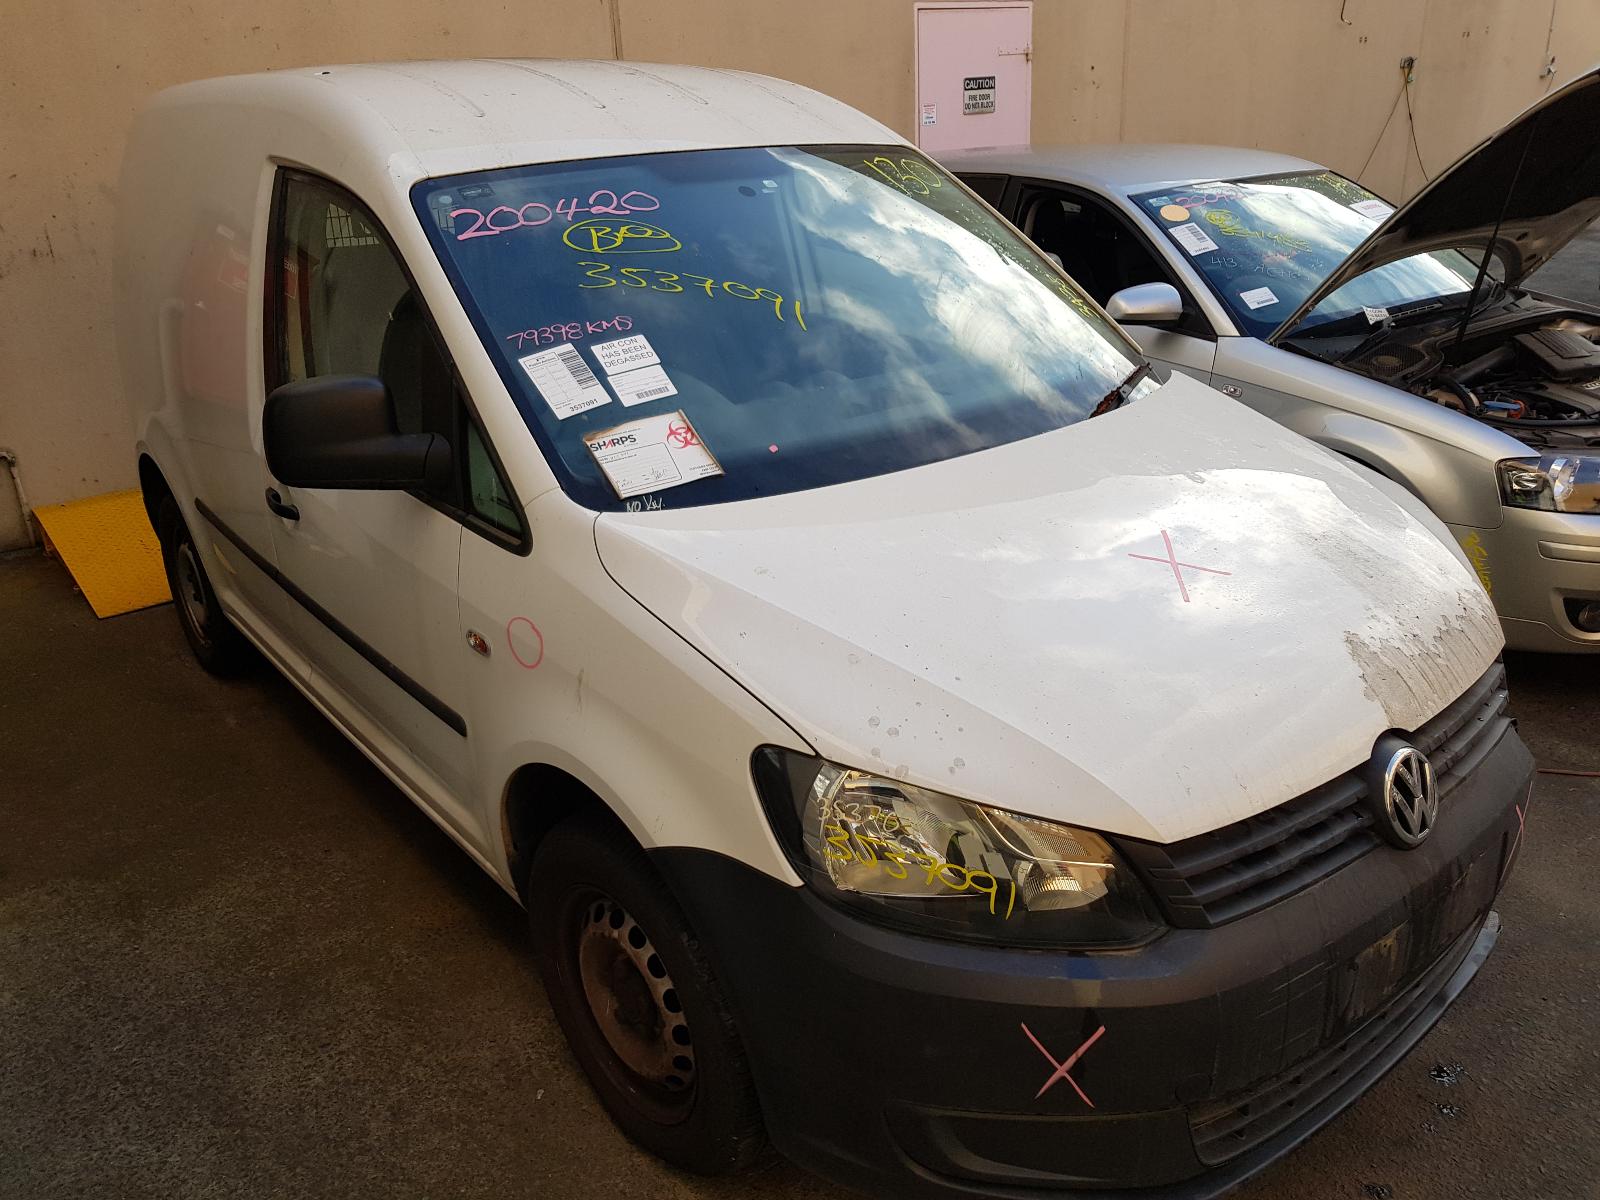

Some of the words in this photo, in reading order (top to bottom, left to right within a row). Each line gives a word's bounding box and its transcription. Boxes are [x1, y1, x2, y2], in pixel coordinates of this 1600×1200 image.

[963, 79, 995, 90] CAUTION
[968, 94, 978, 102] FIRE
[978, 93, 991, 101] DOOR
[980, 101, 994, 109] BLOCK
[449, 189, 660, 241] 200420
[577, 261, 808, 332] 3537091
[506, 322, 585, 350] 79398
[585, 315, 633, 335] KMS
[601, 342, 616, 352] AIR
[617, 337, 638, 348] CON
[601, 349, 621, 361] HAS
[621, 343, 647, 356] BEEN
[603, 351, 655, 369] DEGASSED
[589, 433, 638, 453] SHARPS
